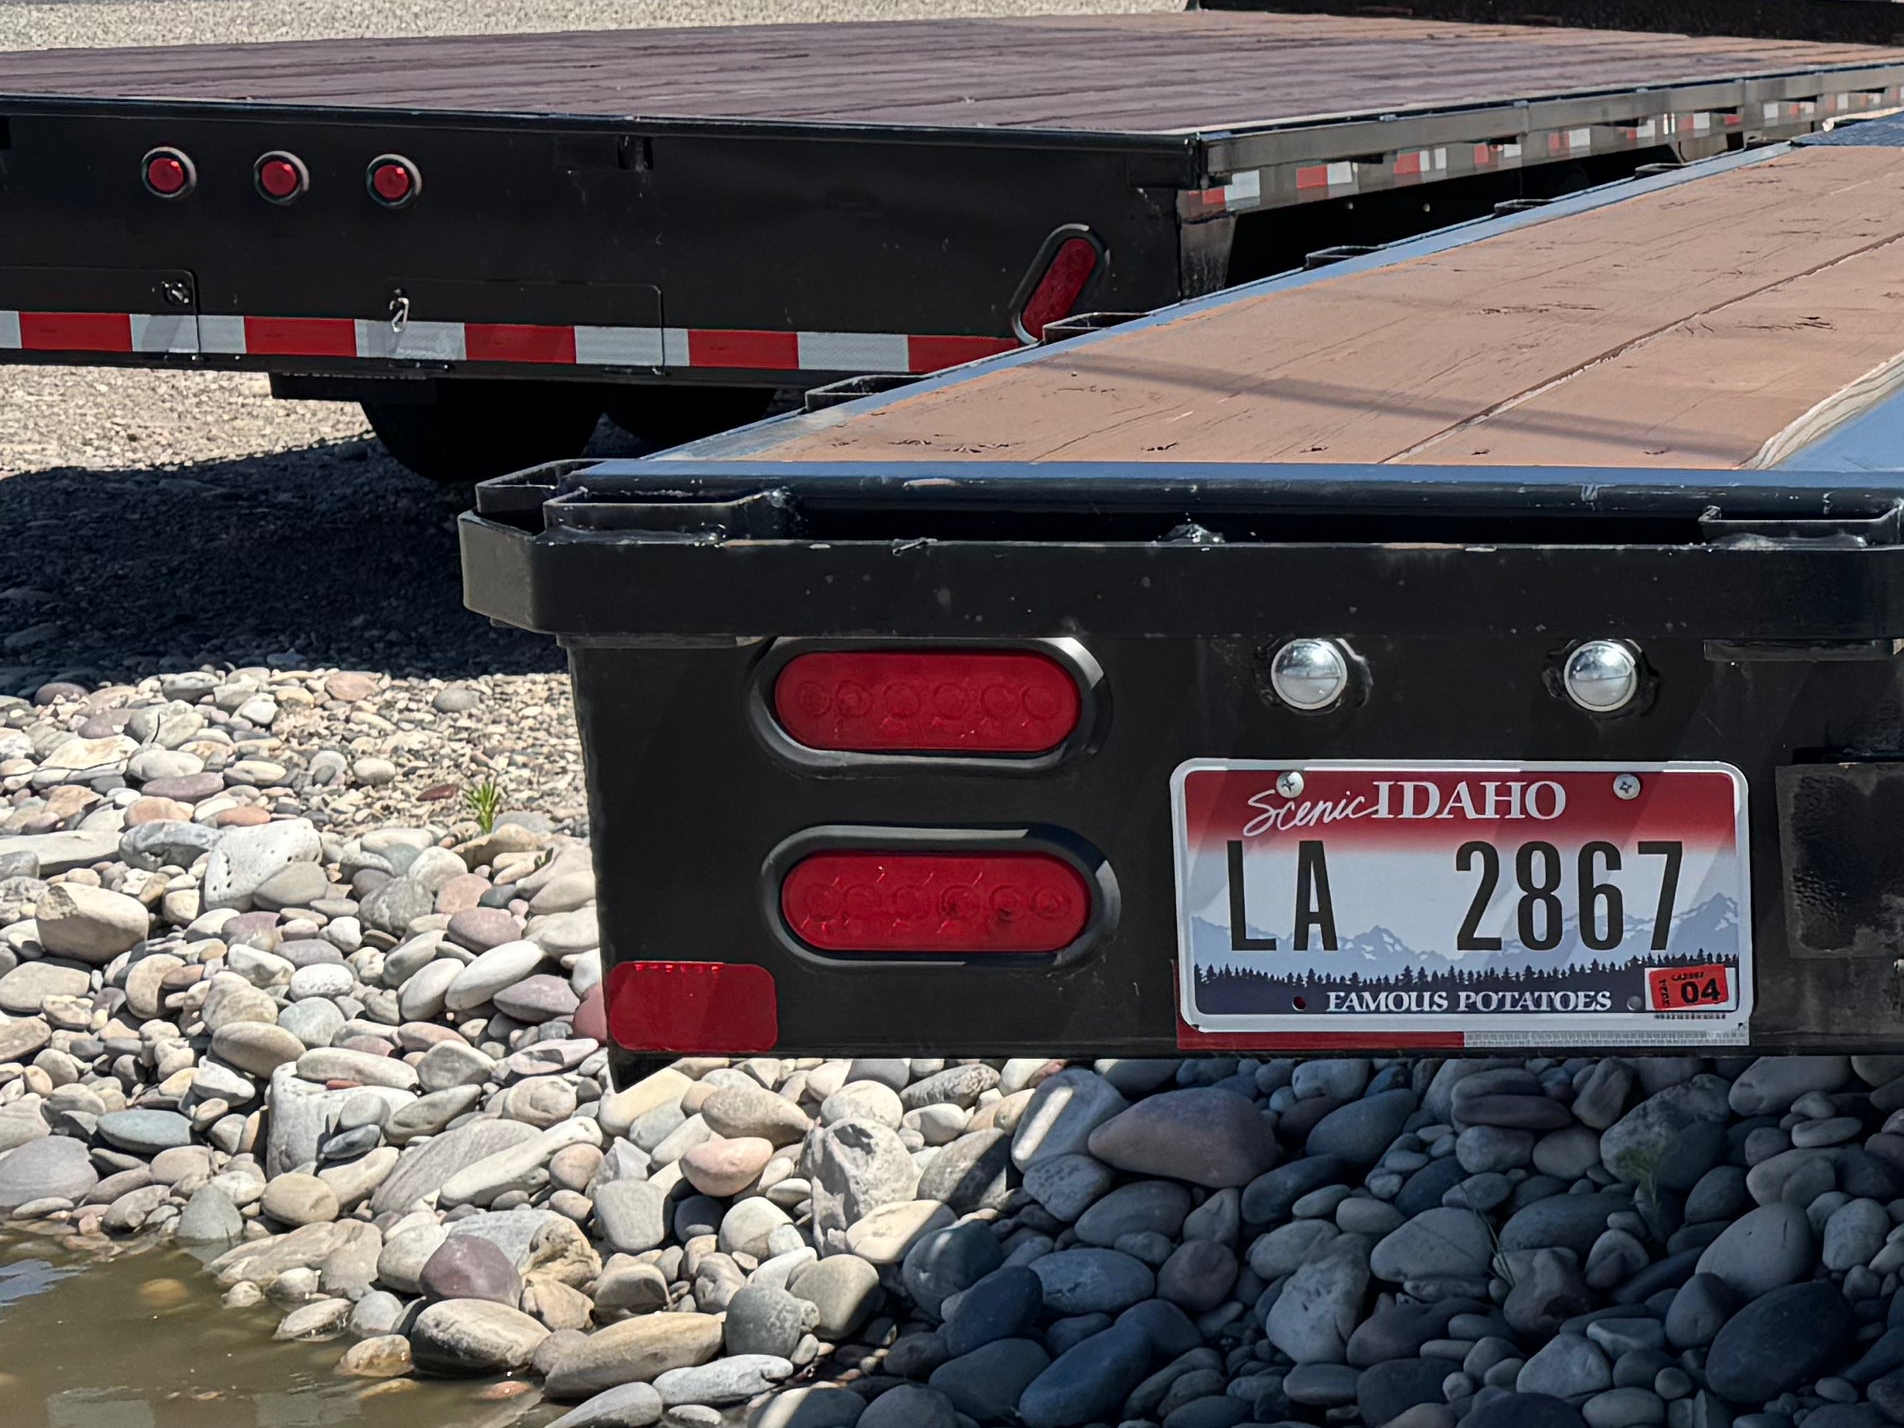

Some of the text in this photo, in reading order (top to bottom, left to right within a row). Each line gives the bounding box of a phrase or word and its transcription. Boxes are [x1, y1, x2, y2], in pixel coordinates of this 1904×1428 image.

[1243, 780, 1567, 837] Scenic IDAHO
[1226, 839, 1684, 952] LA 2867
[1325, 990, 1612, 1013] FAMOUS POTATOES
[1680, 977, 1721, 1004] 04
